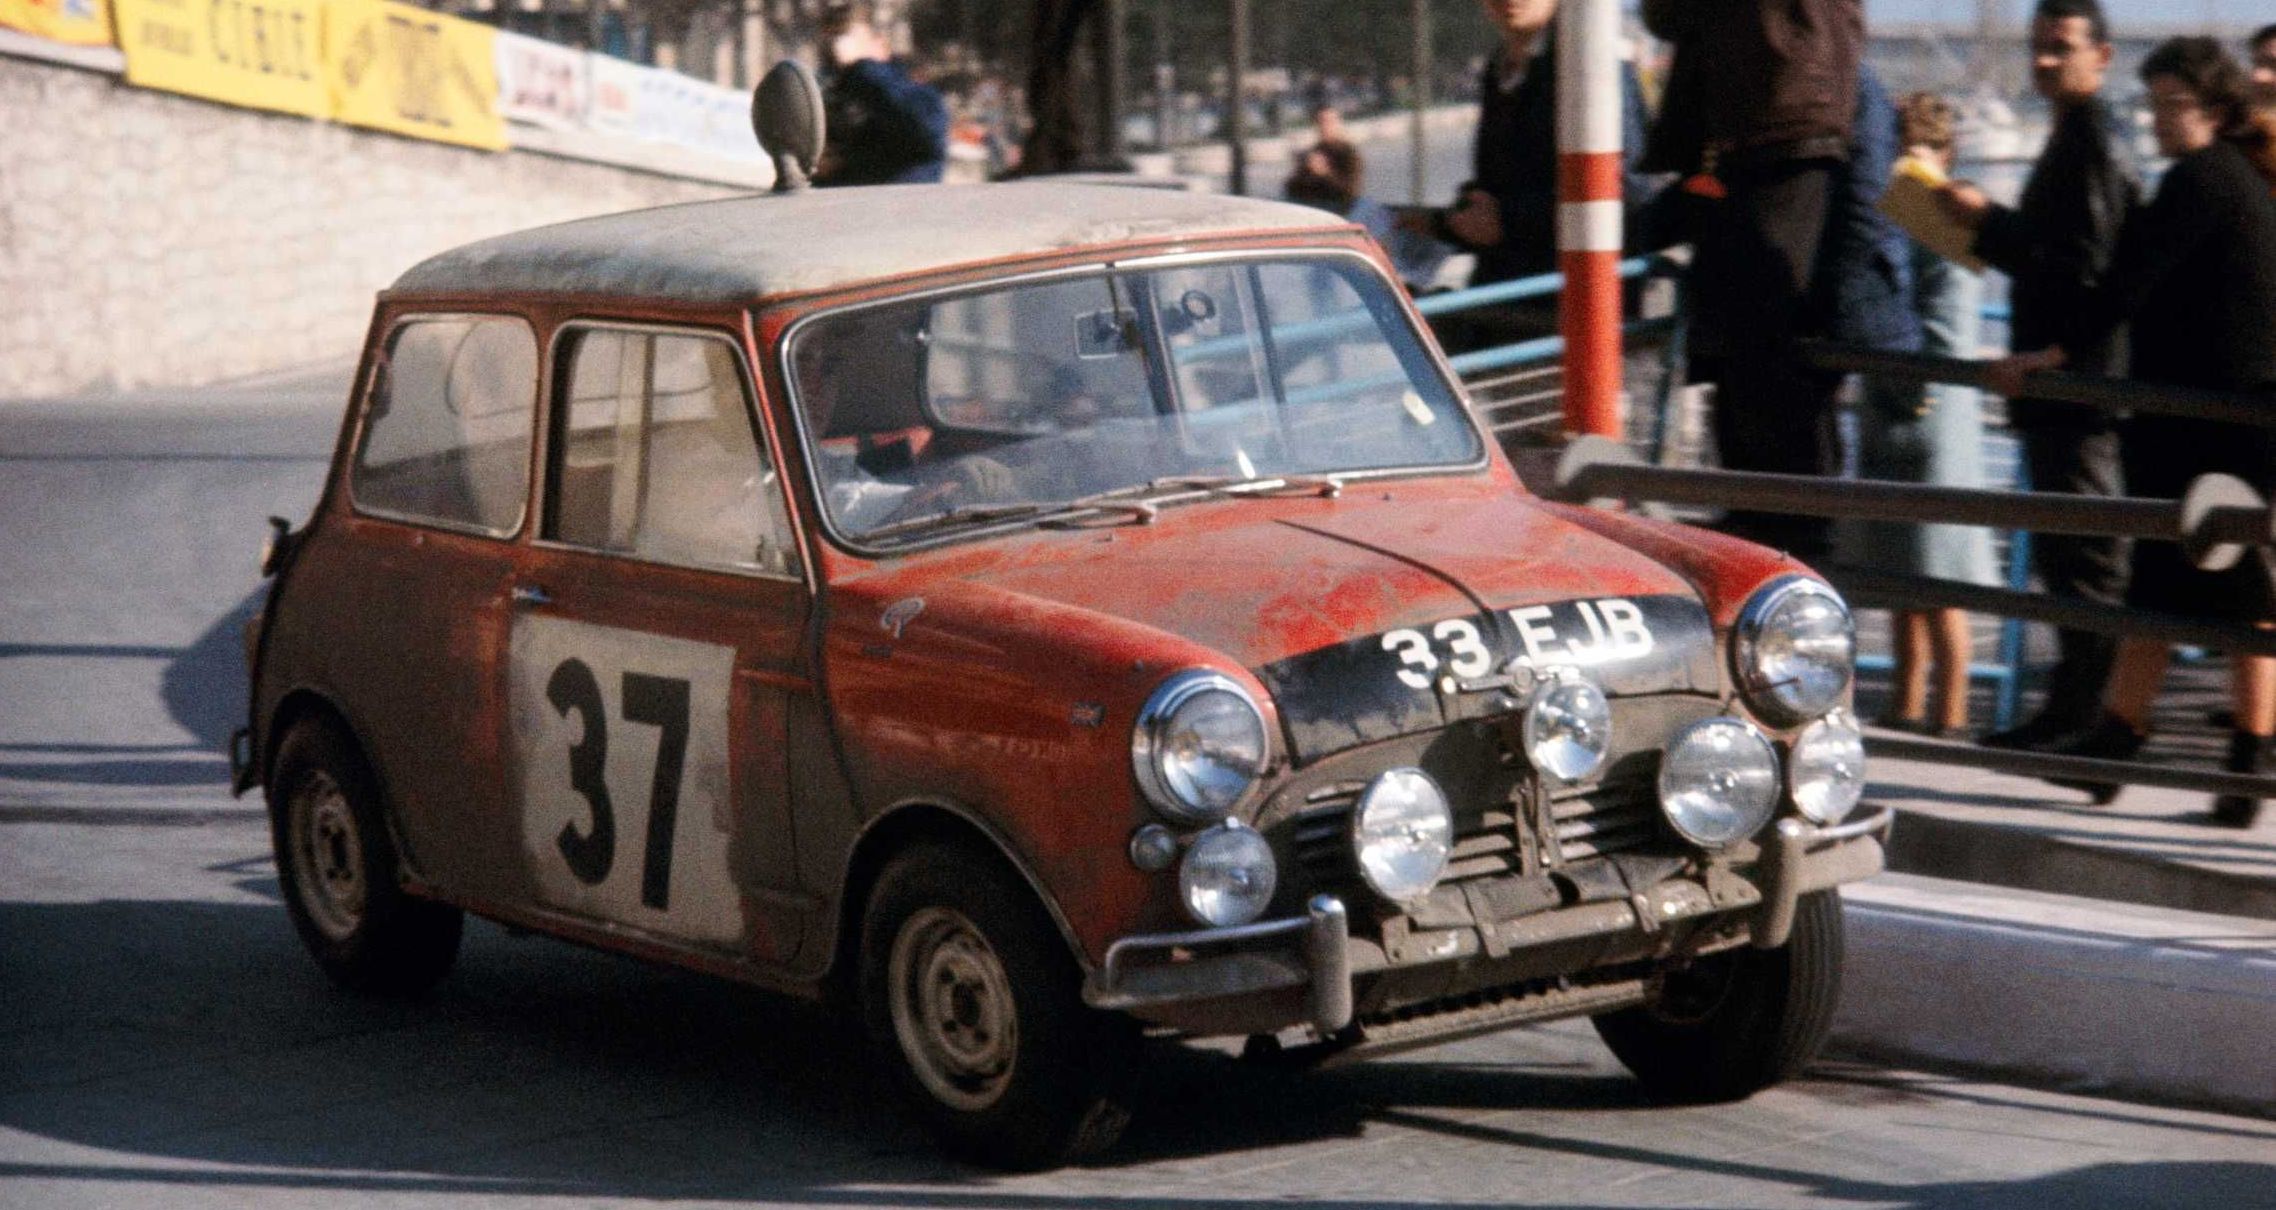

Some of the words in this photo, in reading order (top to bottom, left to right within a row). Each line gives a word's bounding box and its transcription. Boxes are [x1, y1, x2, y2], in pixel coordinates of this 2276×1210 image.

[1381, 618, 1492, 690] 33
[1508, 598, 1656, 666] EJB
[546, 656, 691, 911] 37
